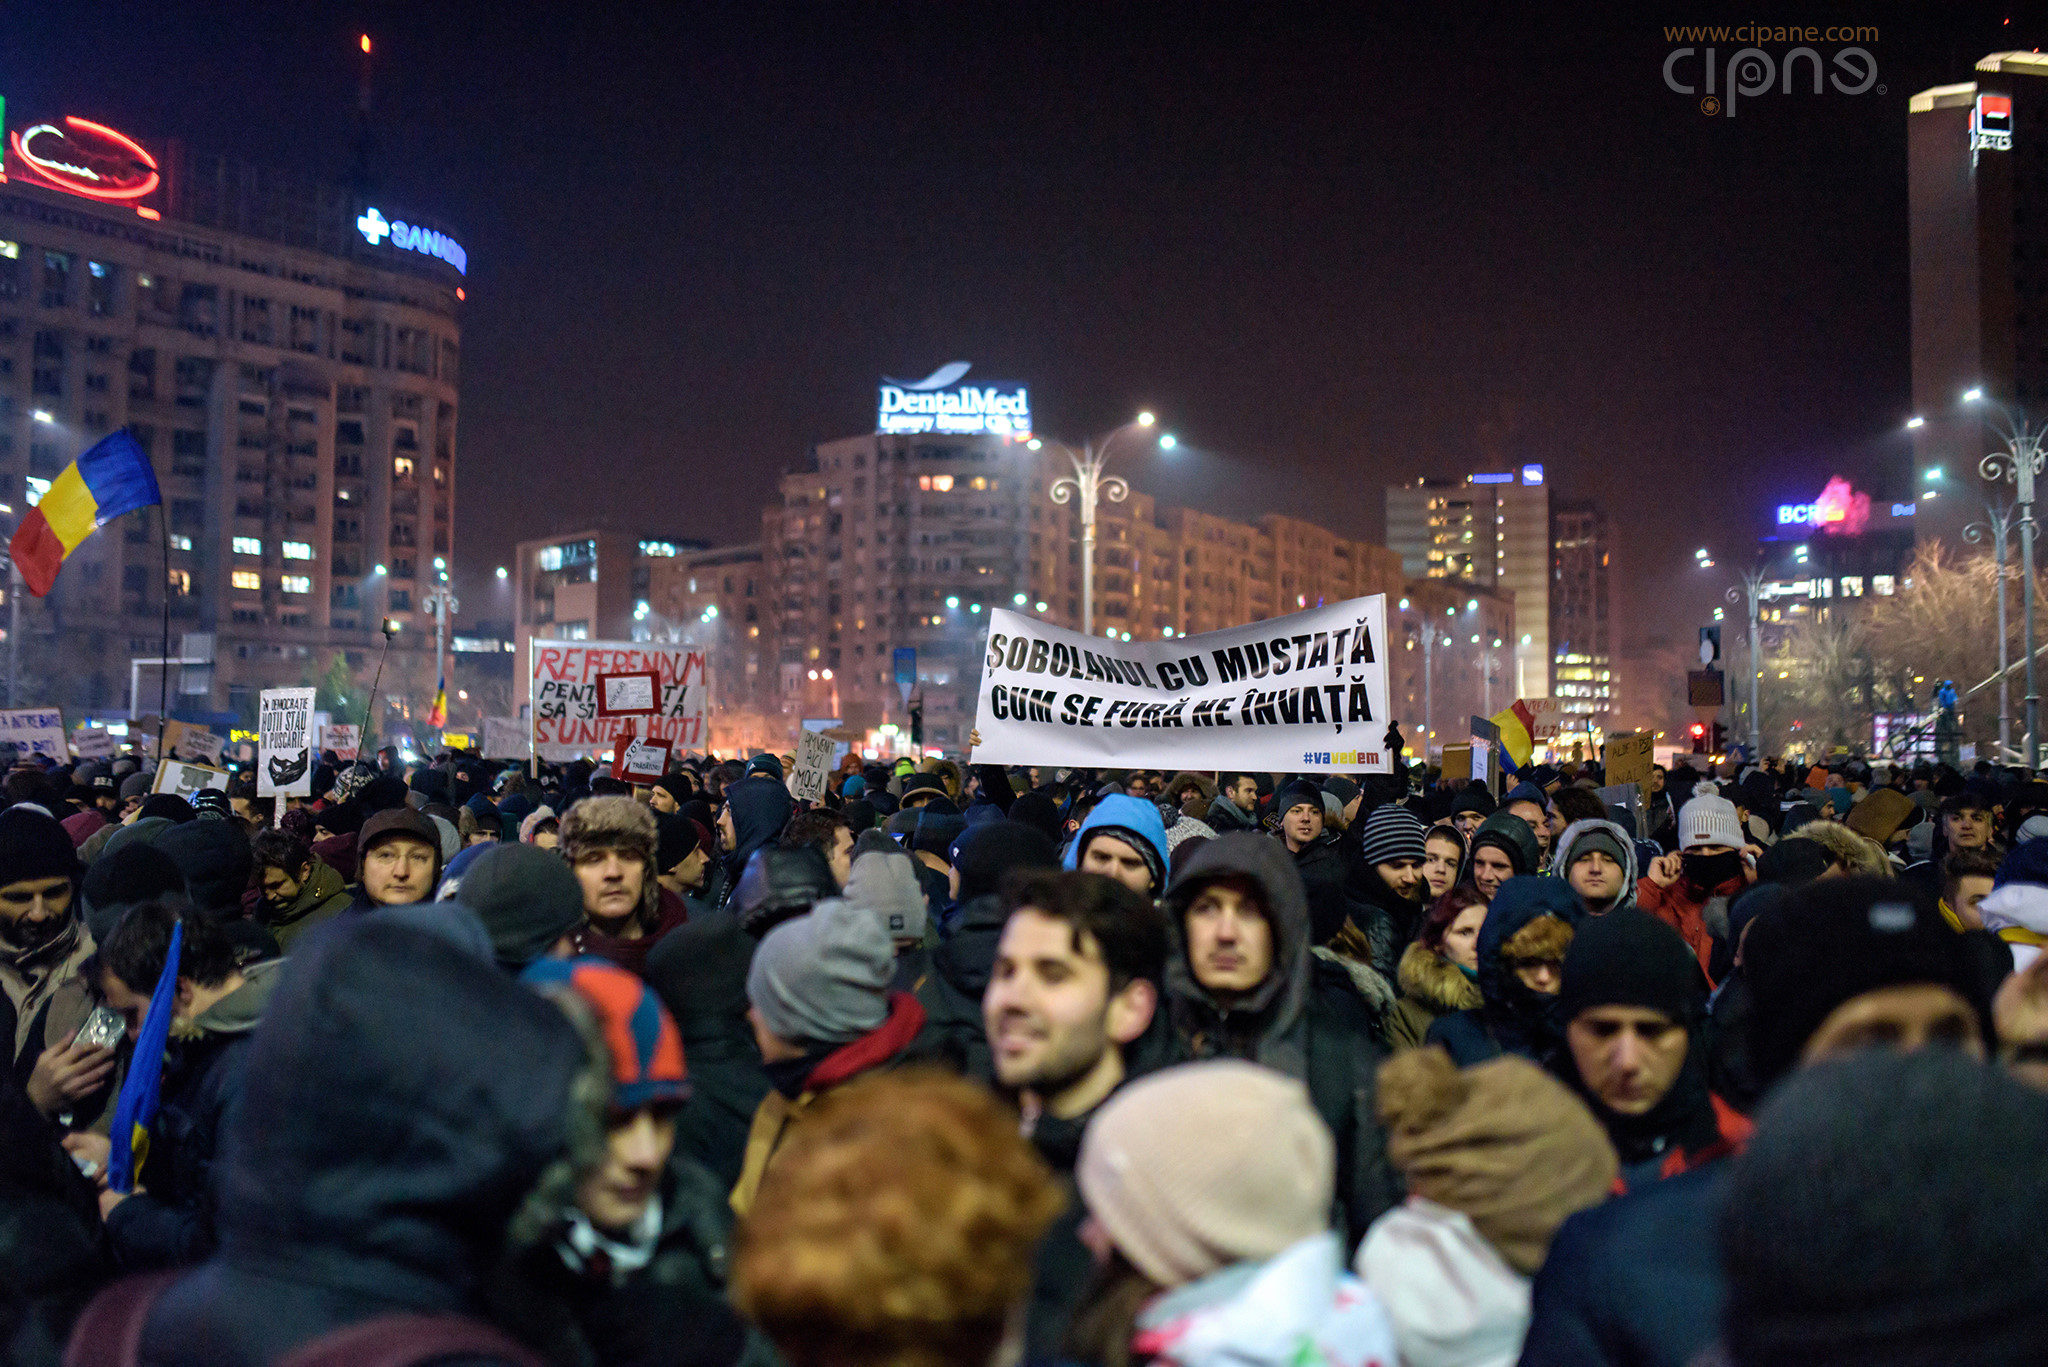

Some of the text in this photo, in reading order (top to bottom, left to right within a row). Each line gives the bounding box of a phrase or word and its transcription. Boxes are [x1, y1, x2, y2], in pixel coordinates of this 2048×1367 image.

[879, 385, 1029, 415] DentalMed
[534, 648, 706, 686] REFERENDUM
[987, 617, 1376, 691] ȘOBOLANUL CU MUSTAȚĂ
[539, 703, 566, 719] SA
[991, 675, 1373, 734] CUM SE FURĂ NE ÎNVAȚĂ
[285, 710, 308, 732] STAU
[536, 717, 637, 745] SUNTEM
[1303, 749, 1380, 765] #vavedem
[794, 769, 823, 793] MOCA
